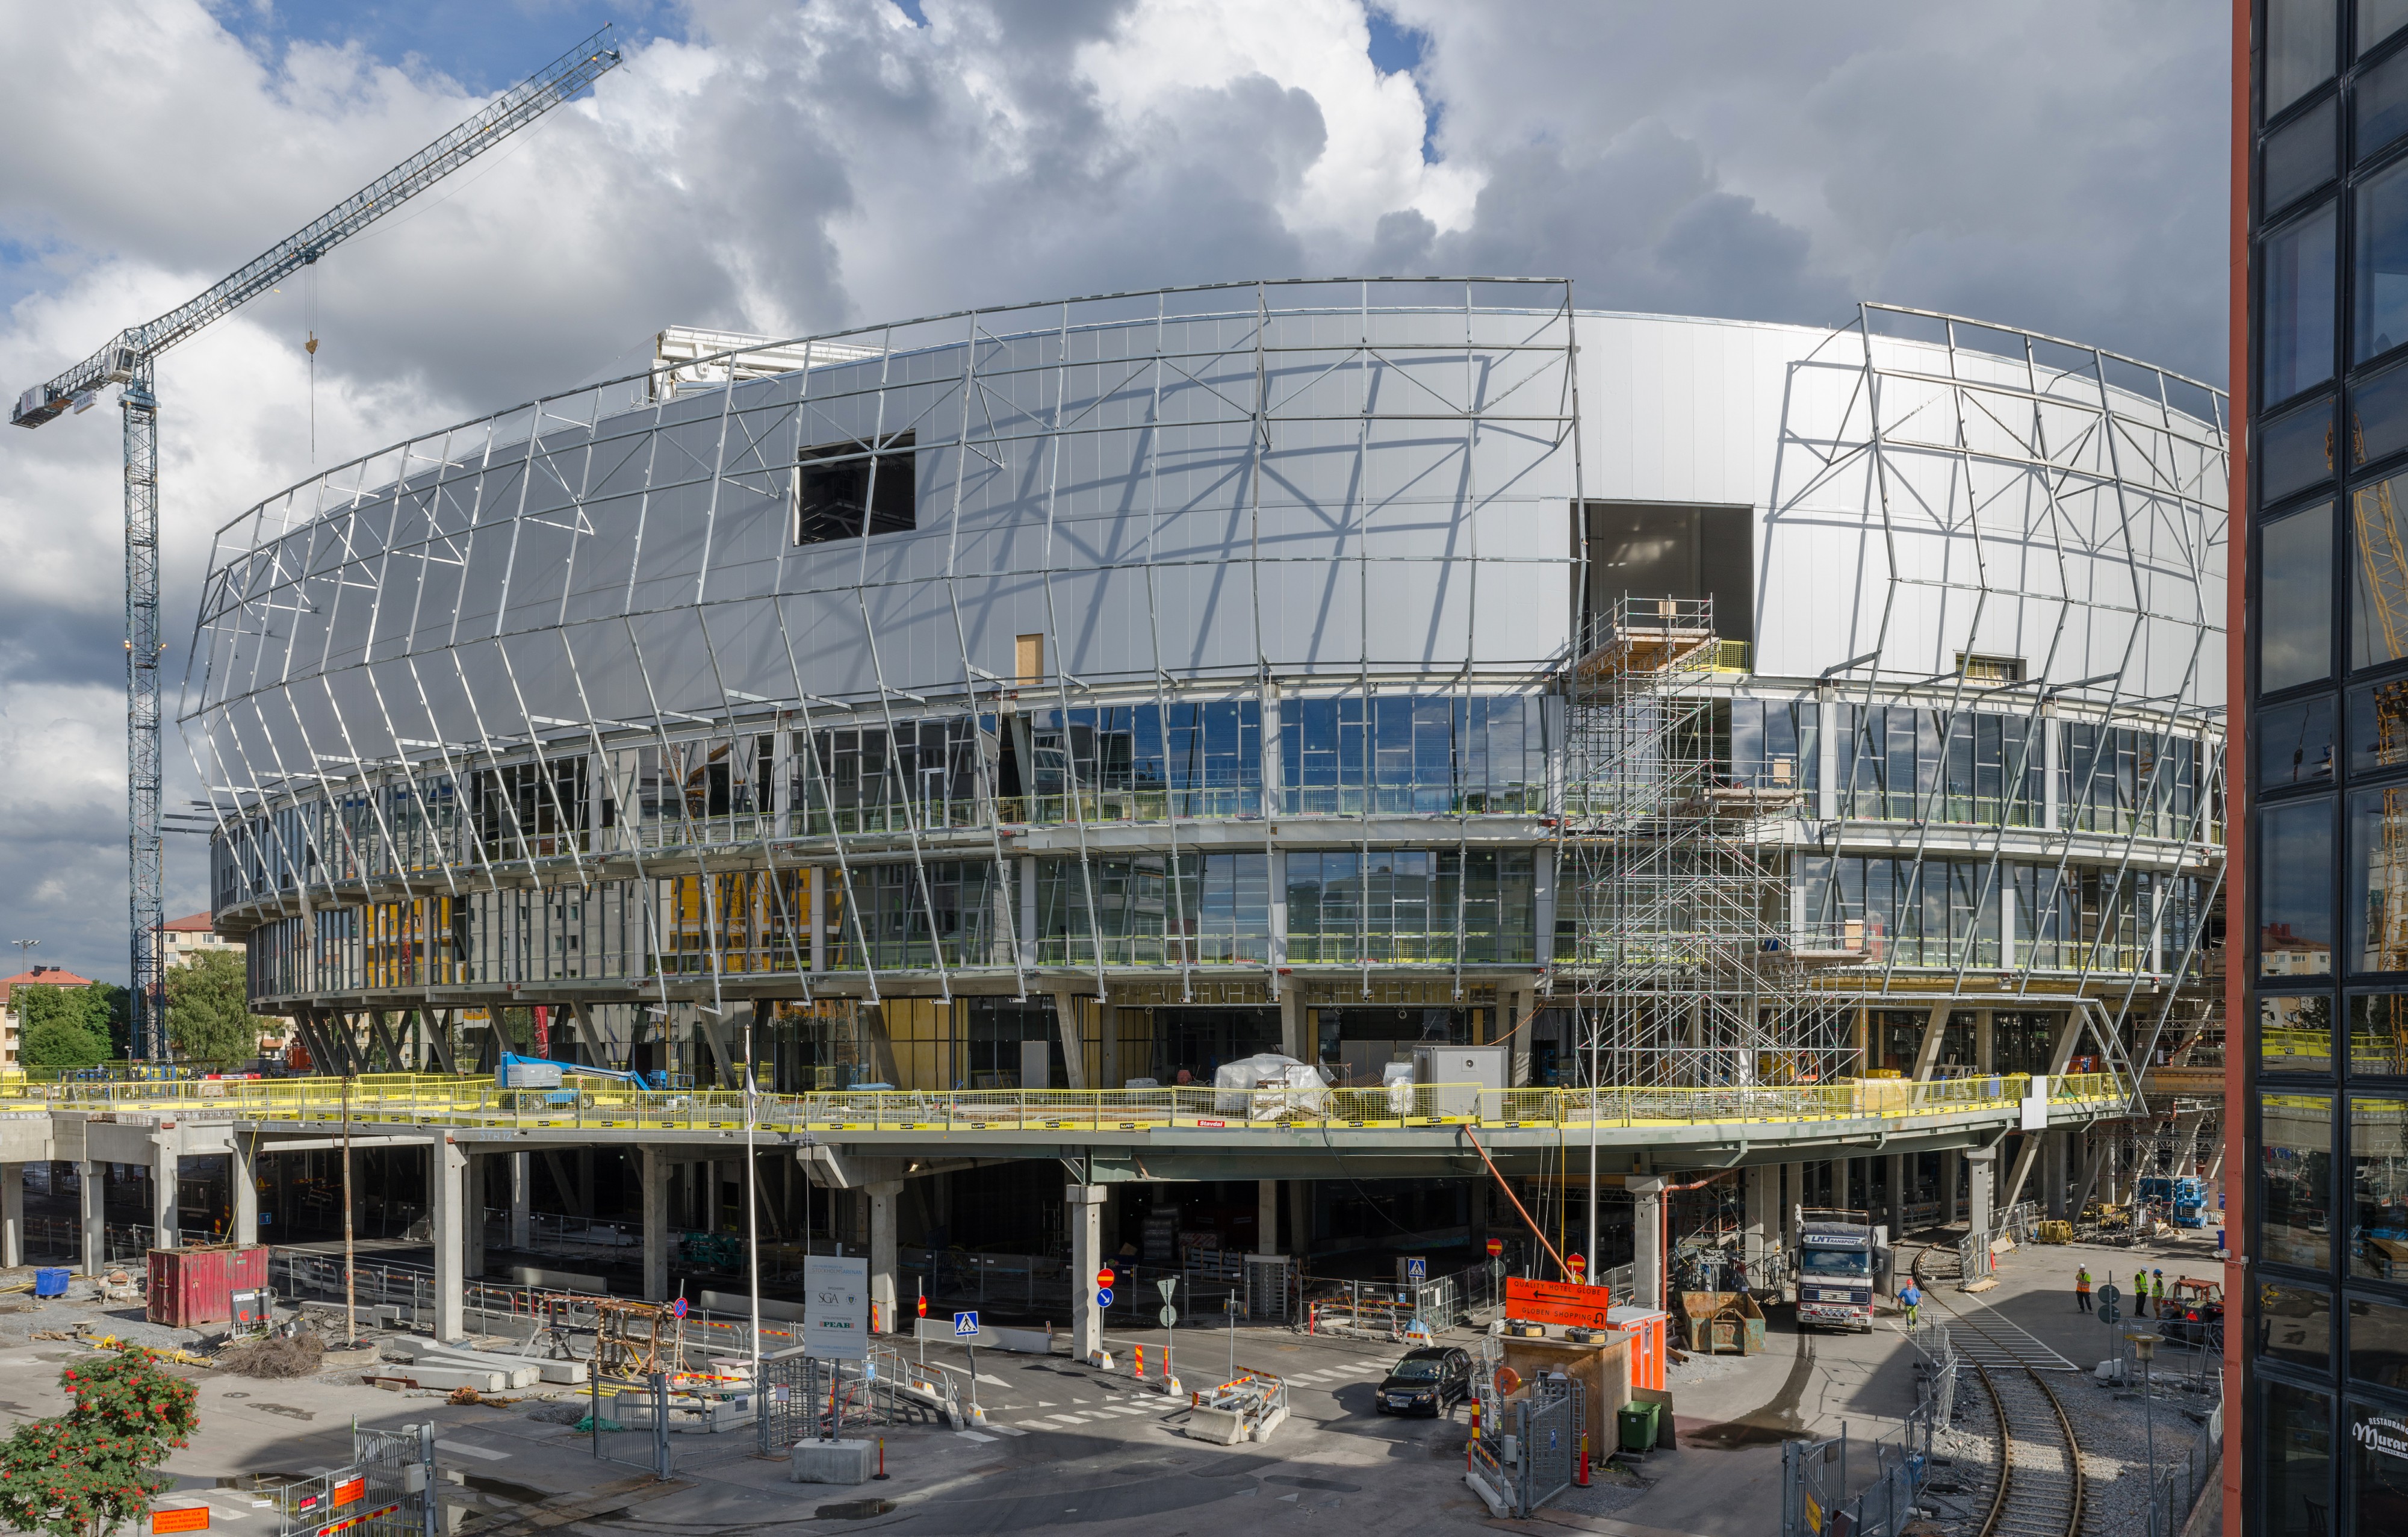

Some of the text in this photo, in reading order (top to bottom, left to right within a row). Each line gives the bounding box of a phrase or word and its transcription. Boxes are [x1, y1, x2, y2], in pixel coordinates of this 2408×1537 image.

[818, 1292, 839, 1304] SGA
[1522, 1307, 1592, 1320] GLOBEN SHOPPING
[301, 1503, 317, 1512] SECURITAS
